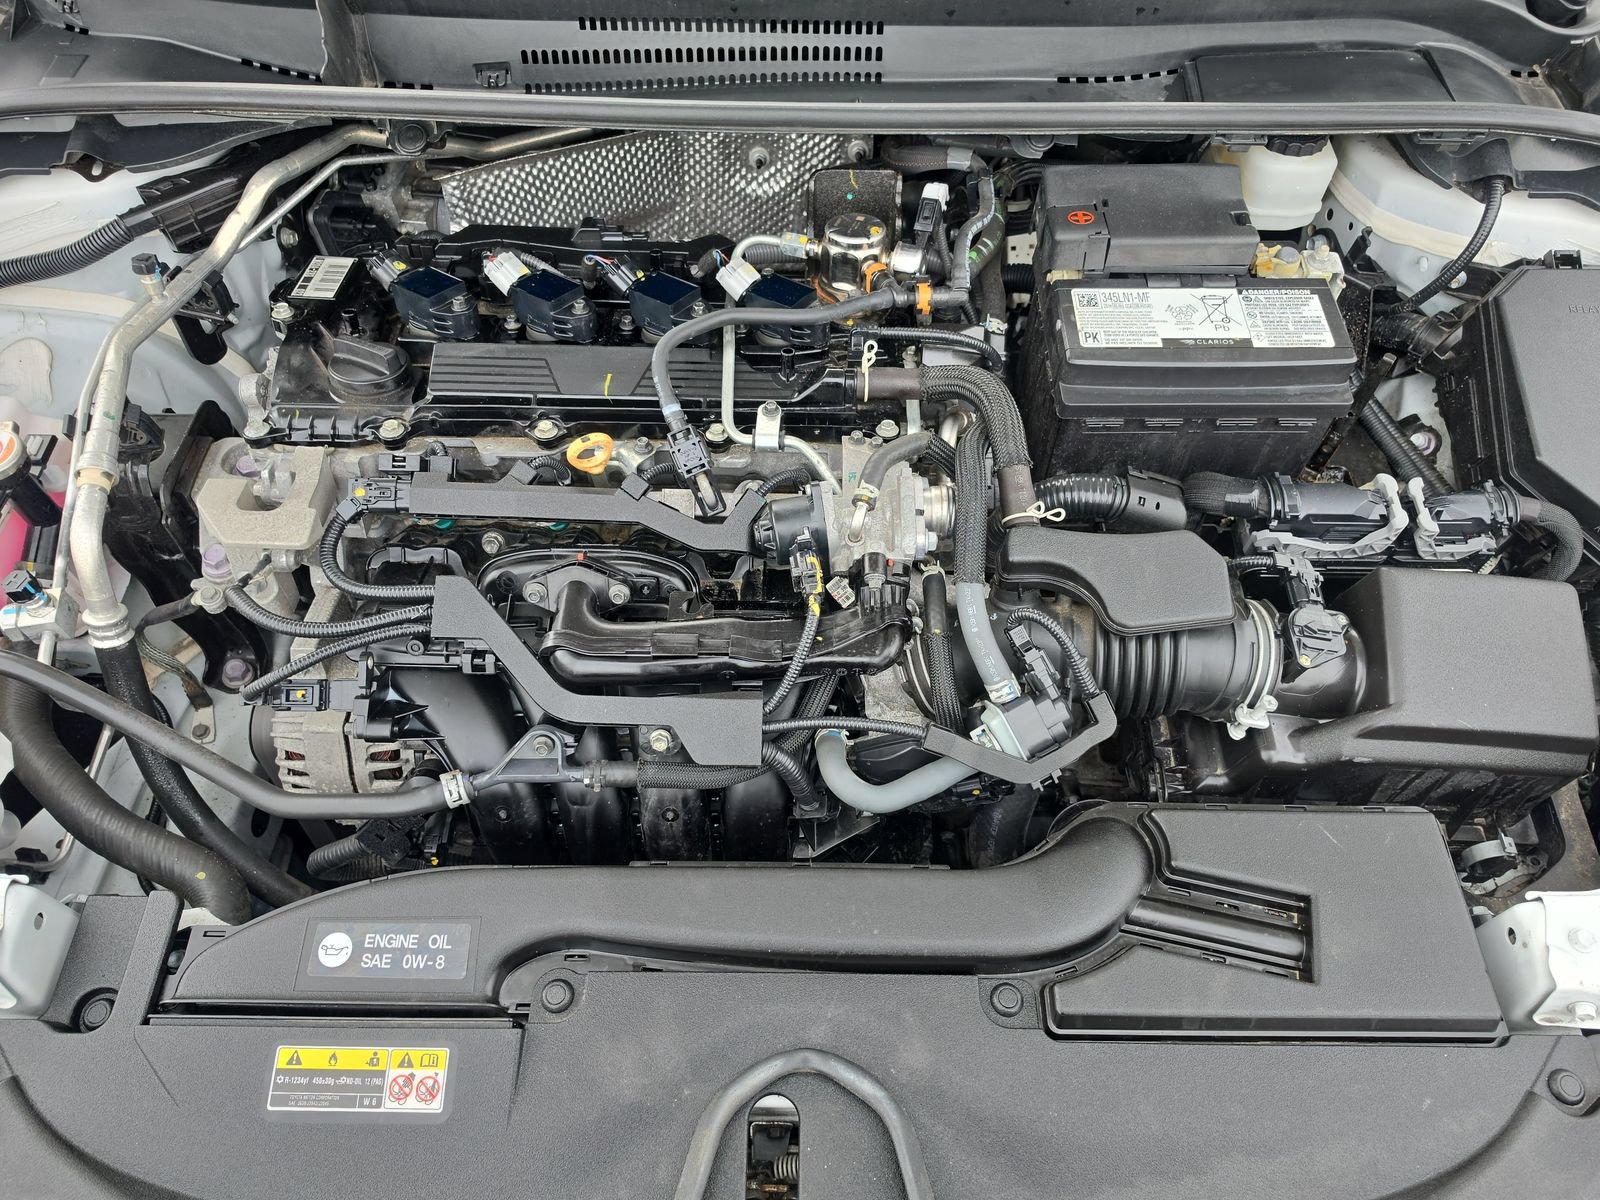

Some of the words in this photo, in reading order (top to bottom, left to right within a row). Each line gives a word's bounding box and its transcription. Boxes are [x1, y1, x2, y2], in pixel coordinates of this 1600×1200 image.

[1101, 292, 1150, 303] 345LN1-MF
[1214, 324, 1230, 332] Pb
[1084, 332, 1100, 343] PK
[364, 934, 419, 949] ENGINE
[428, 934, 452, 949] OIL
[361, 954, 392, 968] SAE
[402, 955, 445, 970] 0W-8
[284, 1076, 310, 1085] R-1234yf
[363, 1097, 371, 1106] W
[372, 1097, 377, 1106] 6
